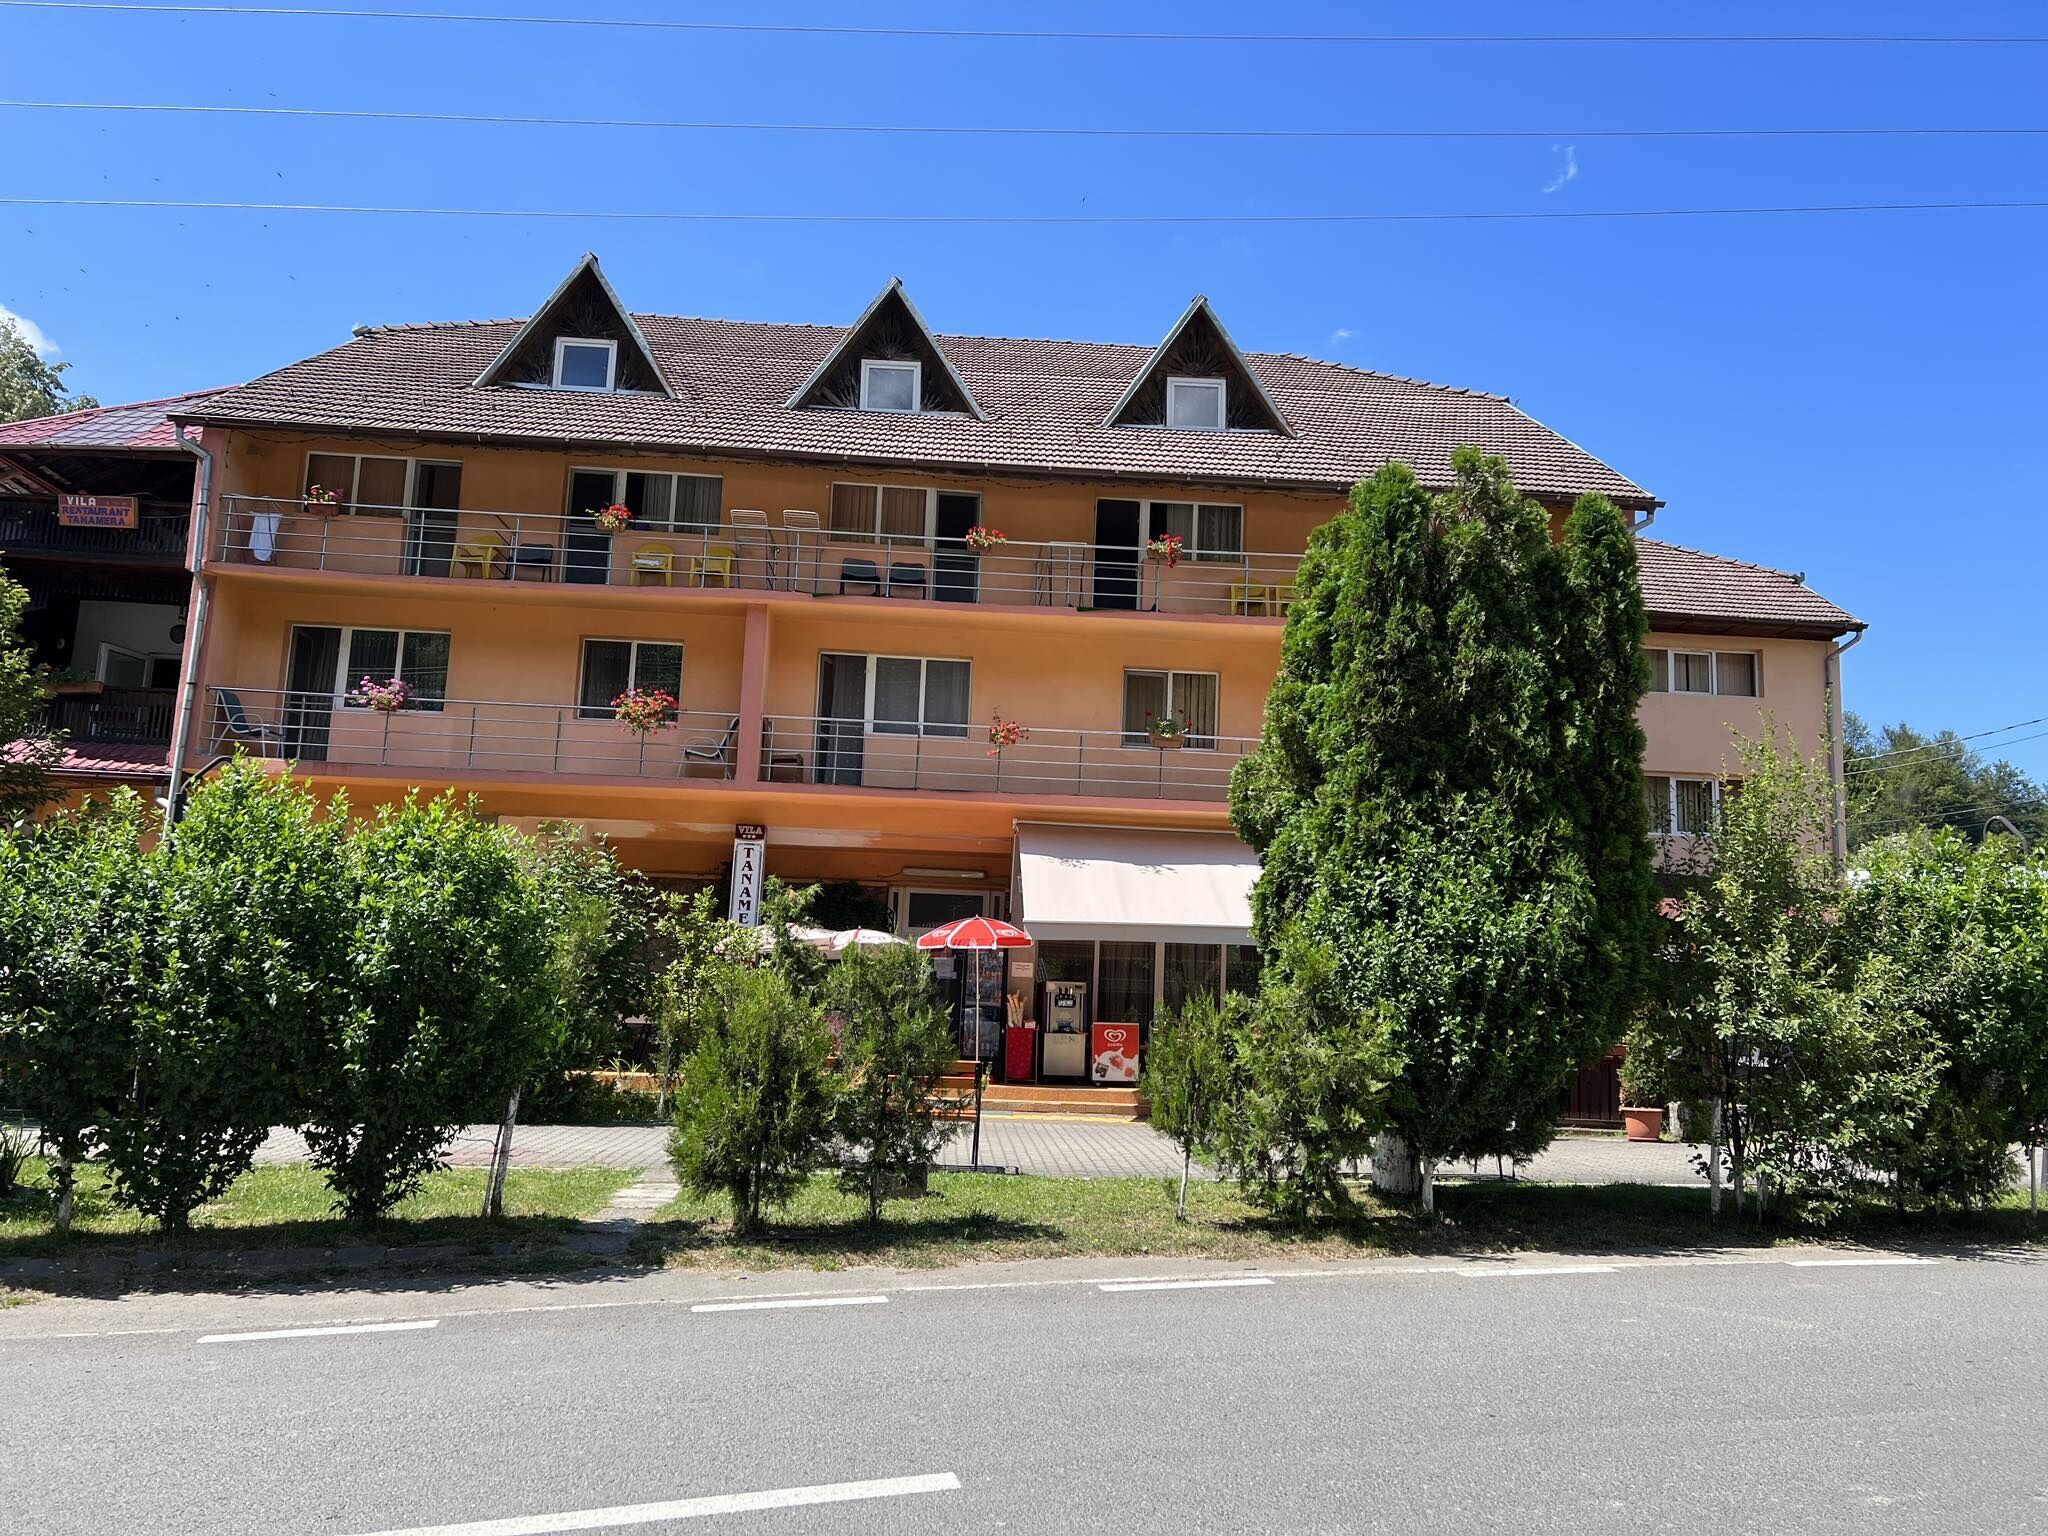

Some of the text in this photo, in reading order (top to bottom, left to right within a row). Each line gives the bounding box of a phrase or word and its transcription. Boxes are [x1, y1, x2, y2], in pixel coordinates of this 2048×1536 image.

[67, 496, 96, 506] VILA
[62, 506, 130, 516] RESTAURANT
[66, 515, 126, 526] TANAMERA
[738, 825, 763, 835] VILA
[737, 847, 754, 928] TANAME
